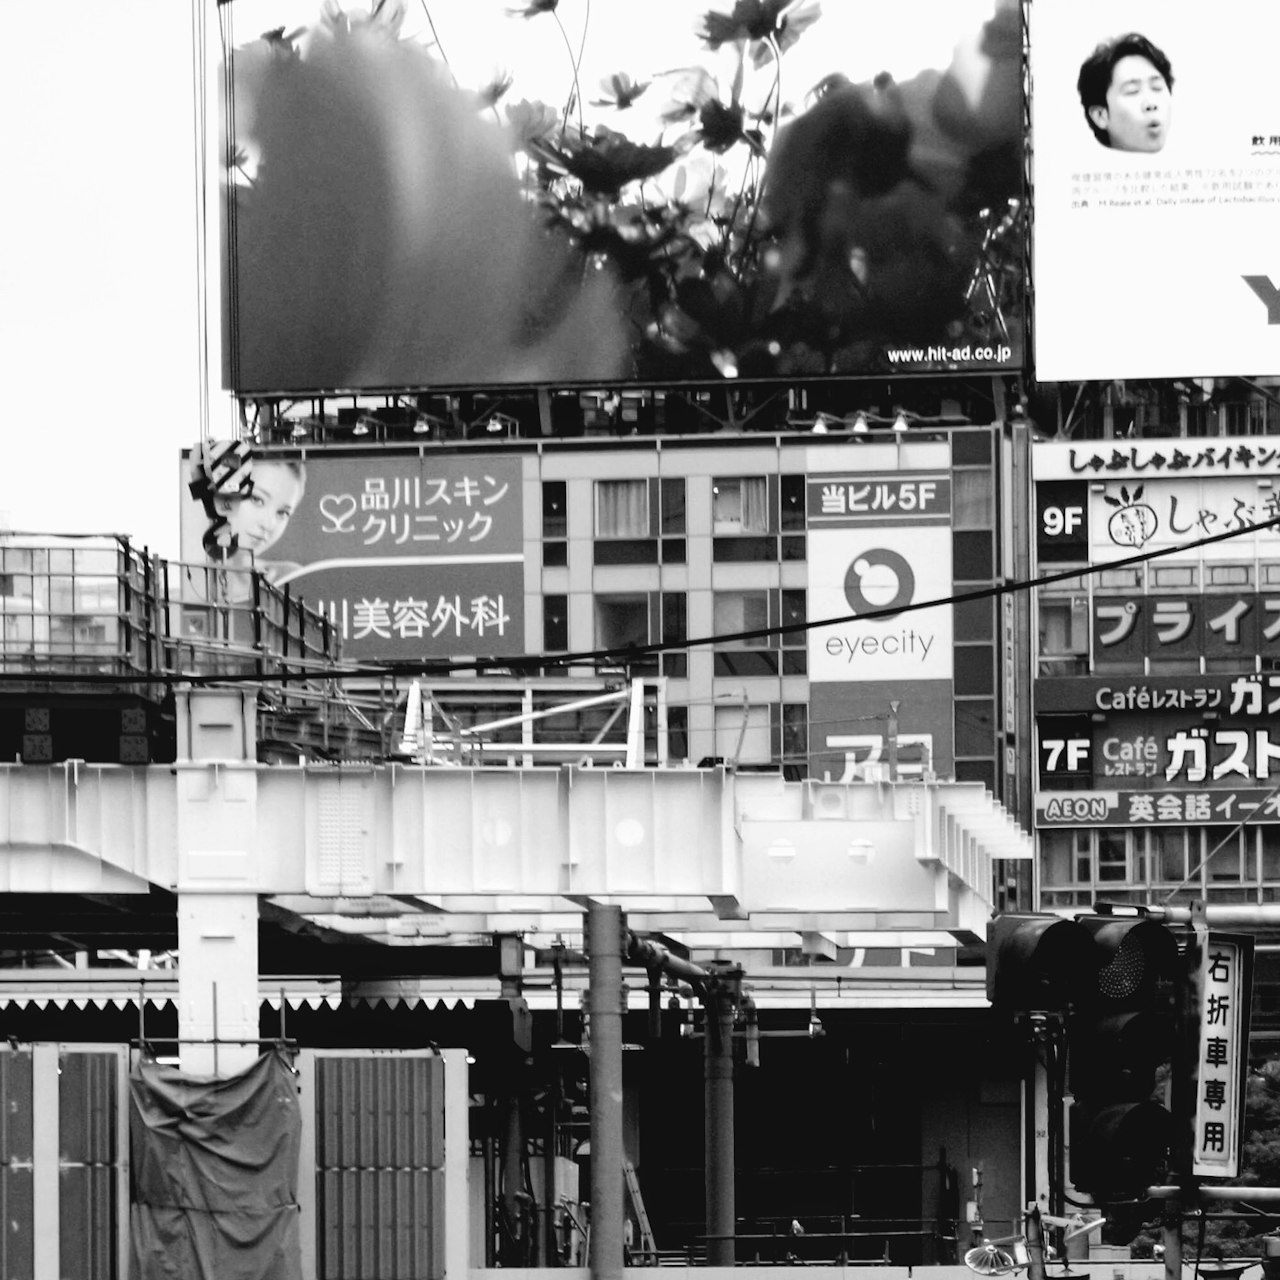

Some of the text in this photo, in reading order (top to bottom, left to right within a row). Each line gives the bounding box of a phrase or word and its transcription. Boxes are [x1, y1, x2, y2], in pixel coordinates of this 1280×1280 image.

[887, 344, 1012, 363] www.hit-ad.co.jp
[361, 475, 508, 511] 品川スキン
[821, 483, 936, 513] 当ビル5F
[362, 511, 492, 545] クリニック
[1043, 507, 1083, 536] 9F
[826, 630, 934, 663] eyecity
[1042, 739, 1090, 771] 7F
[1102, 736, 1158, 761] Café
[1104, 762, 1158, 777] レストラン
[1046, 799, 1108, 819] AEON
[1202, 951, 1231, 1153] 右折車専用
